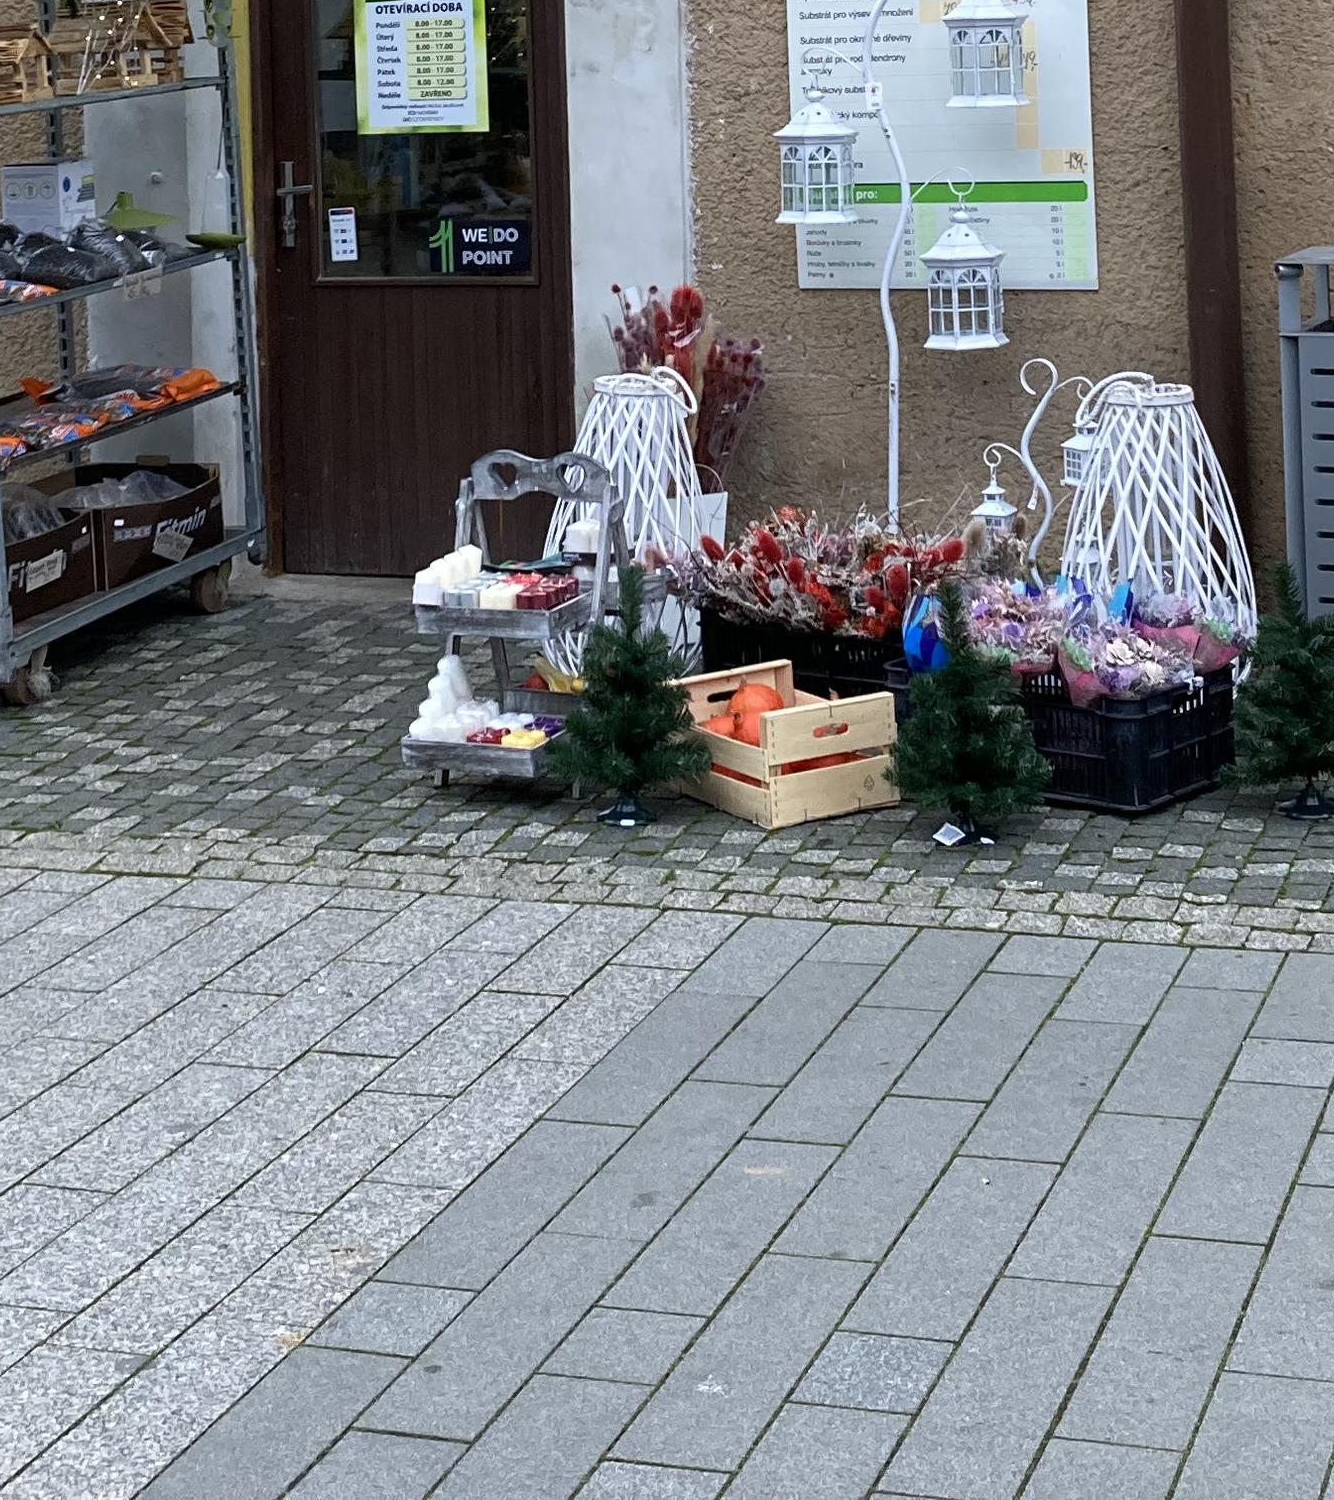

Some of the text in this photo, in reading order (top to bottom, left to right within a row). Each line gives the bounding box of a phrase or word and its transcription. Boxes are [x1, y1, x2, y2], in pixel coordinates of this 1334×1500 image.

[376, 1, 463, 15] OTEVÍRACÍ DOBA
[799, 11, 831, 20] Substrát
[833, 11, 847, 20] pro
[800, 37, 833, 45] Substrát
[834, 37, 847, 45] pro
[856, 190, 878, 201] pro:
[462, 251, 514, 265] POINT
